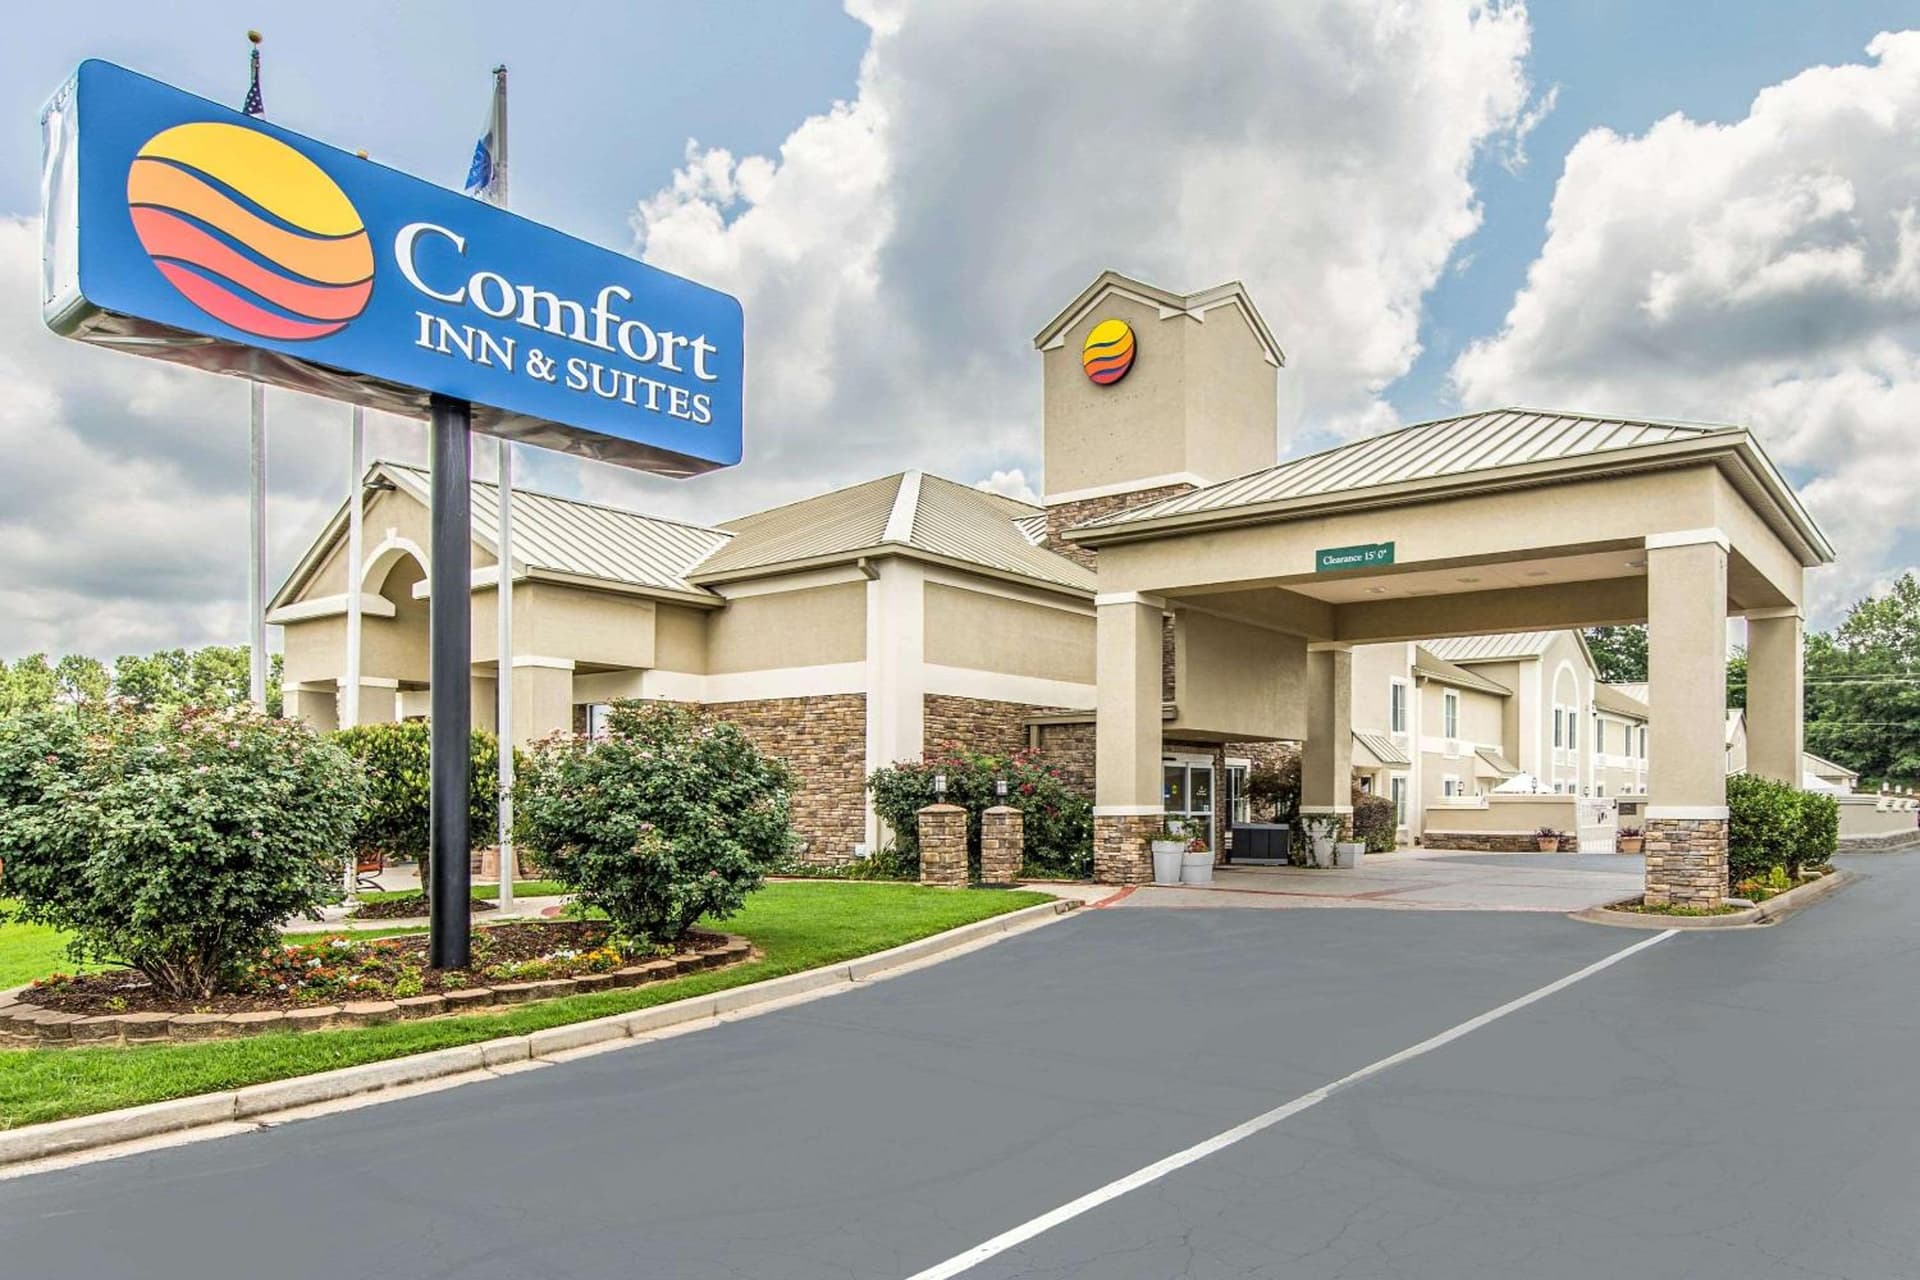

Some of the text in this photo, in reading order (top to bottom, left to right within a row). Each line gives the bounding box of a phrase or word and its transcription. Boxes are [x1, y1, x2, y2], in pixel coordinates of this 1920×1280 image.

[394, 222, 718, 380] Comfort
[415, 311, 712, 423] INN & SUITES
[1323, 554, 1362, 565] Clearance
